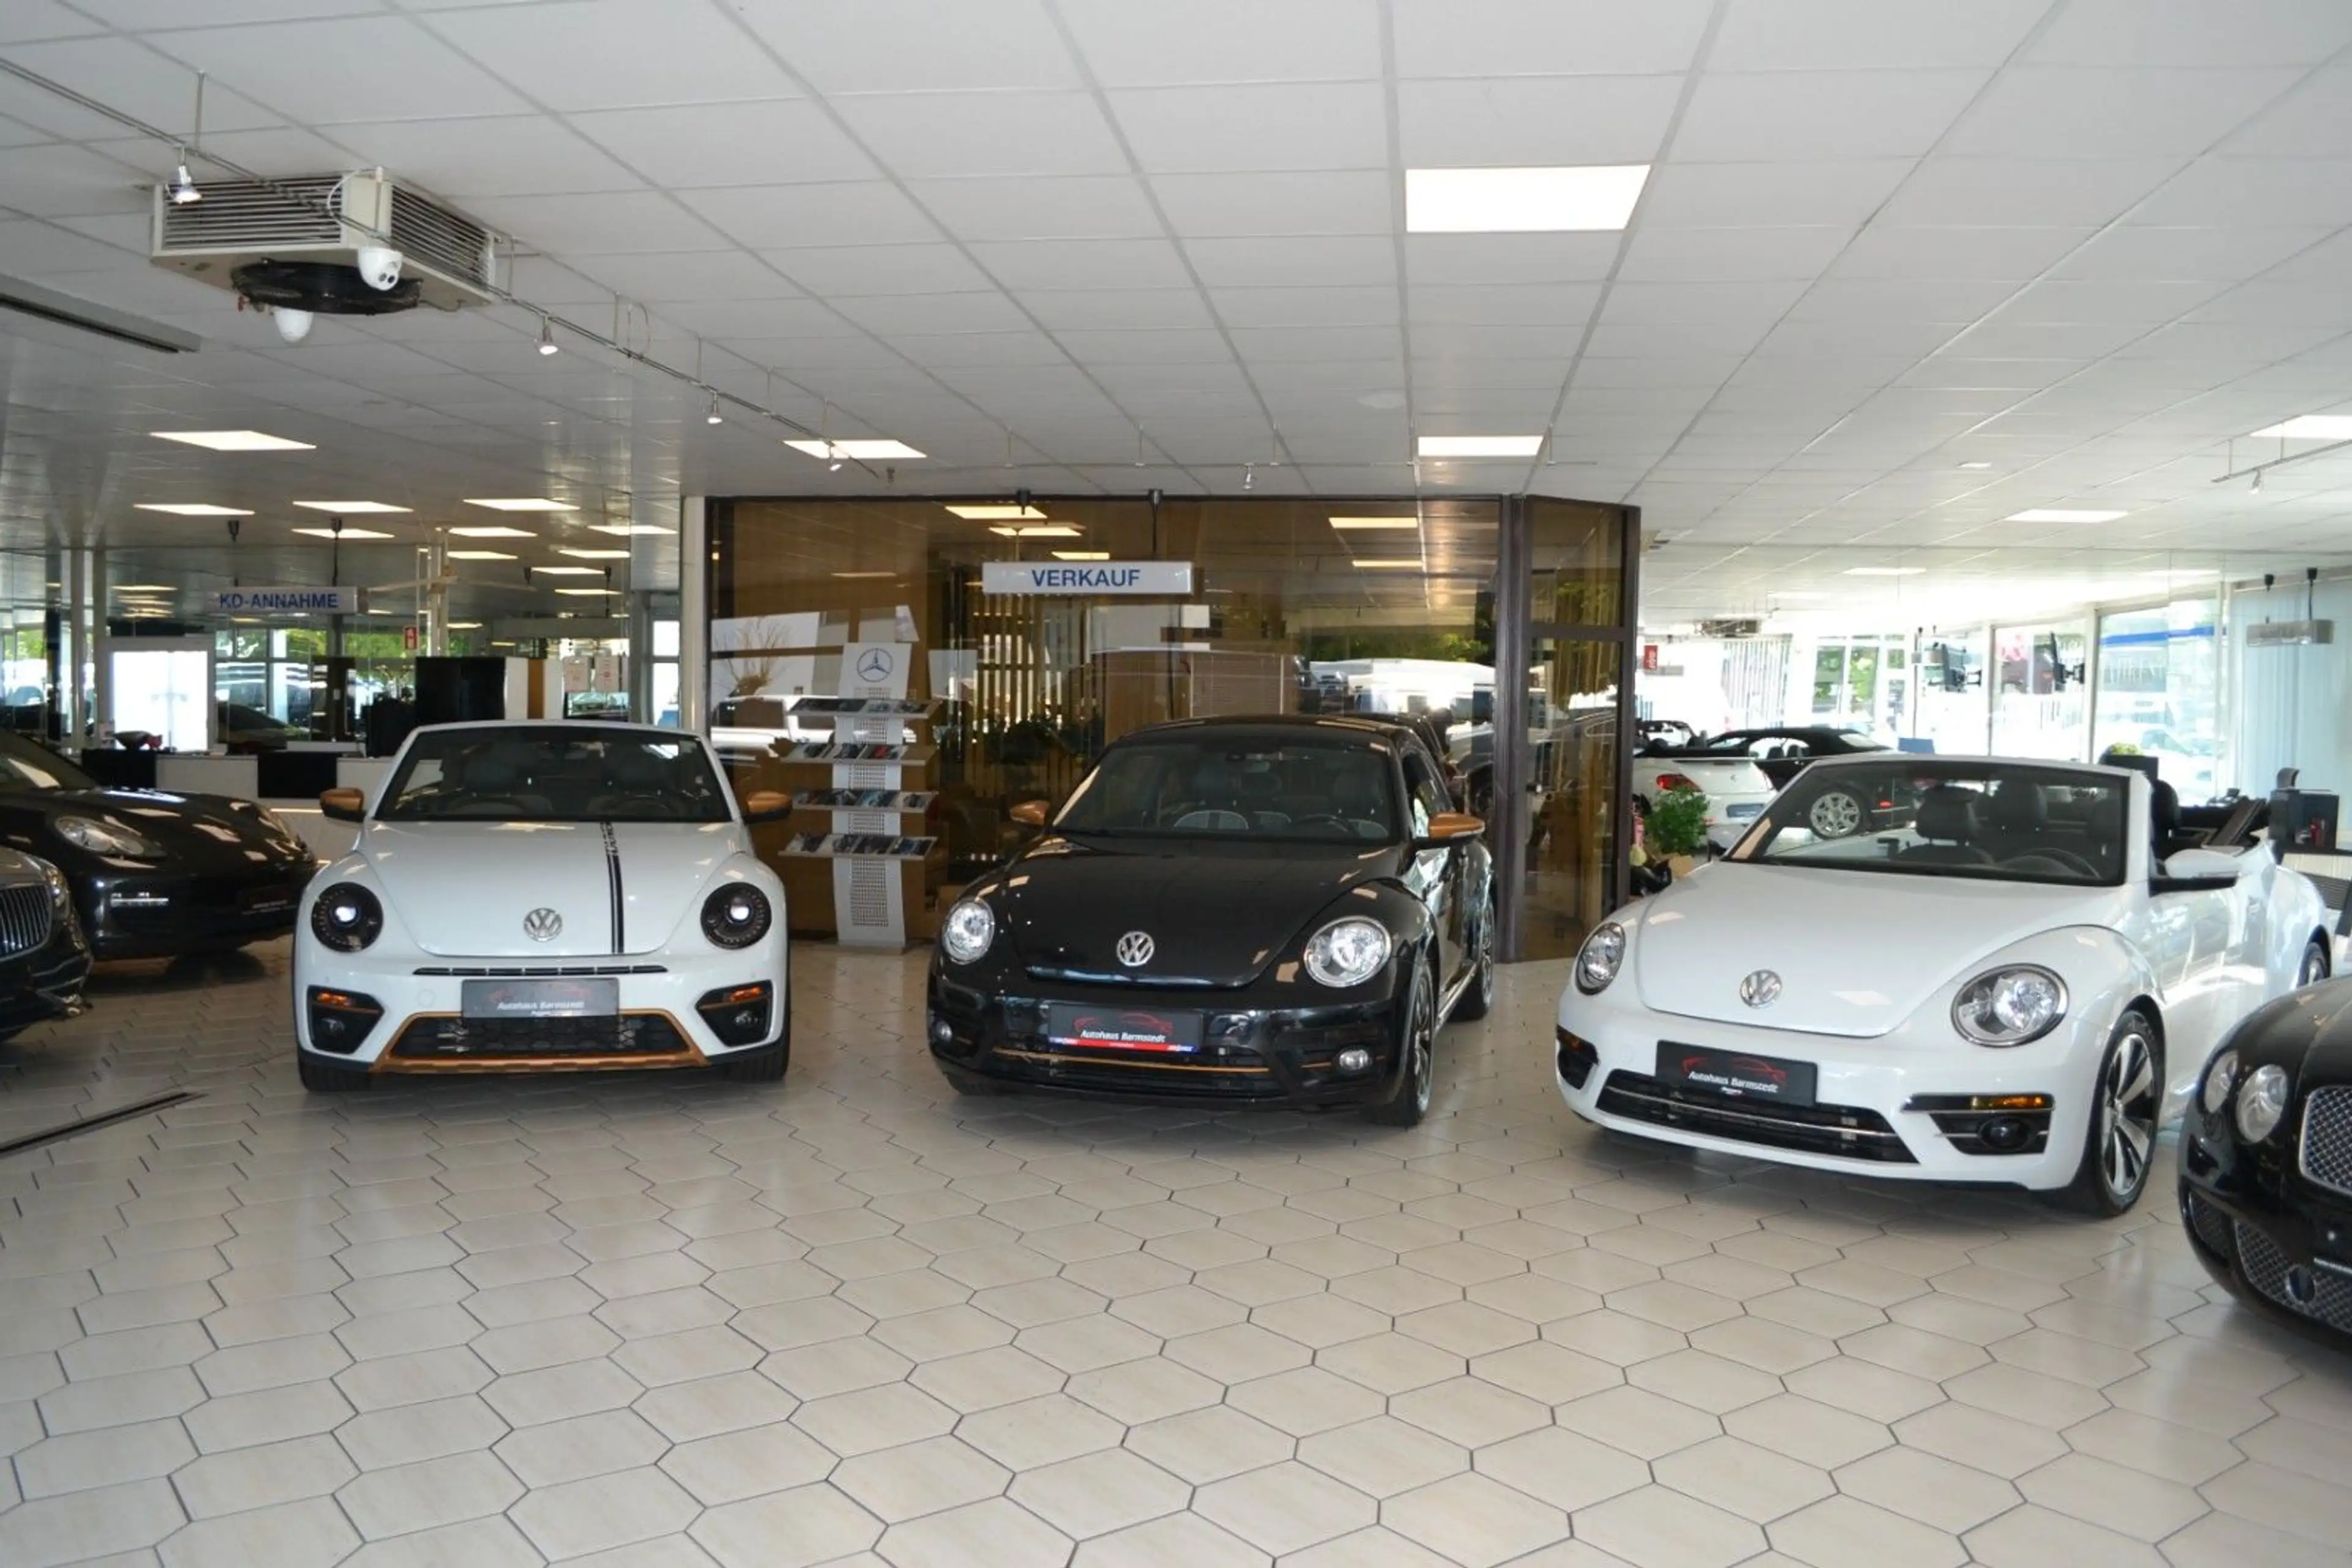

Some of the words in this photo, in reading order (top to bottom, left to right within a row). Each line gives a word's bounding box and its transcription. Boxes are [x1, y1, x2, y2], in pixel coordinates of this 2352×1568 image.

[1031, 569, 1140, 587] VERKAUF
[220, 592, 339, 609] KD-ANNAHME
[1080, 1029, 1120, 1041] Autohaus
[1687, 1070, 1729, 1085] Autohaus
